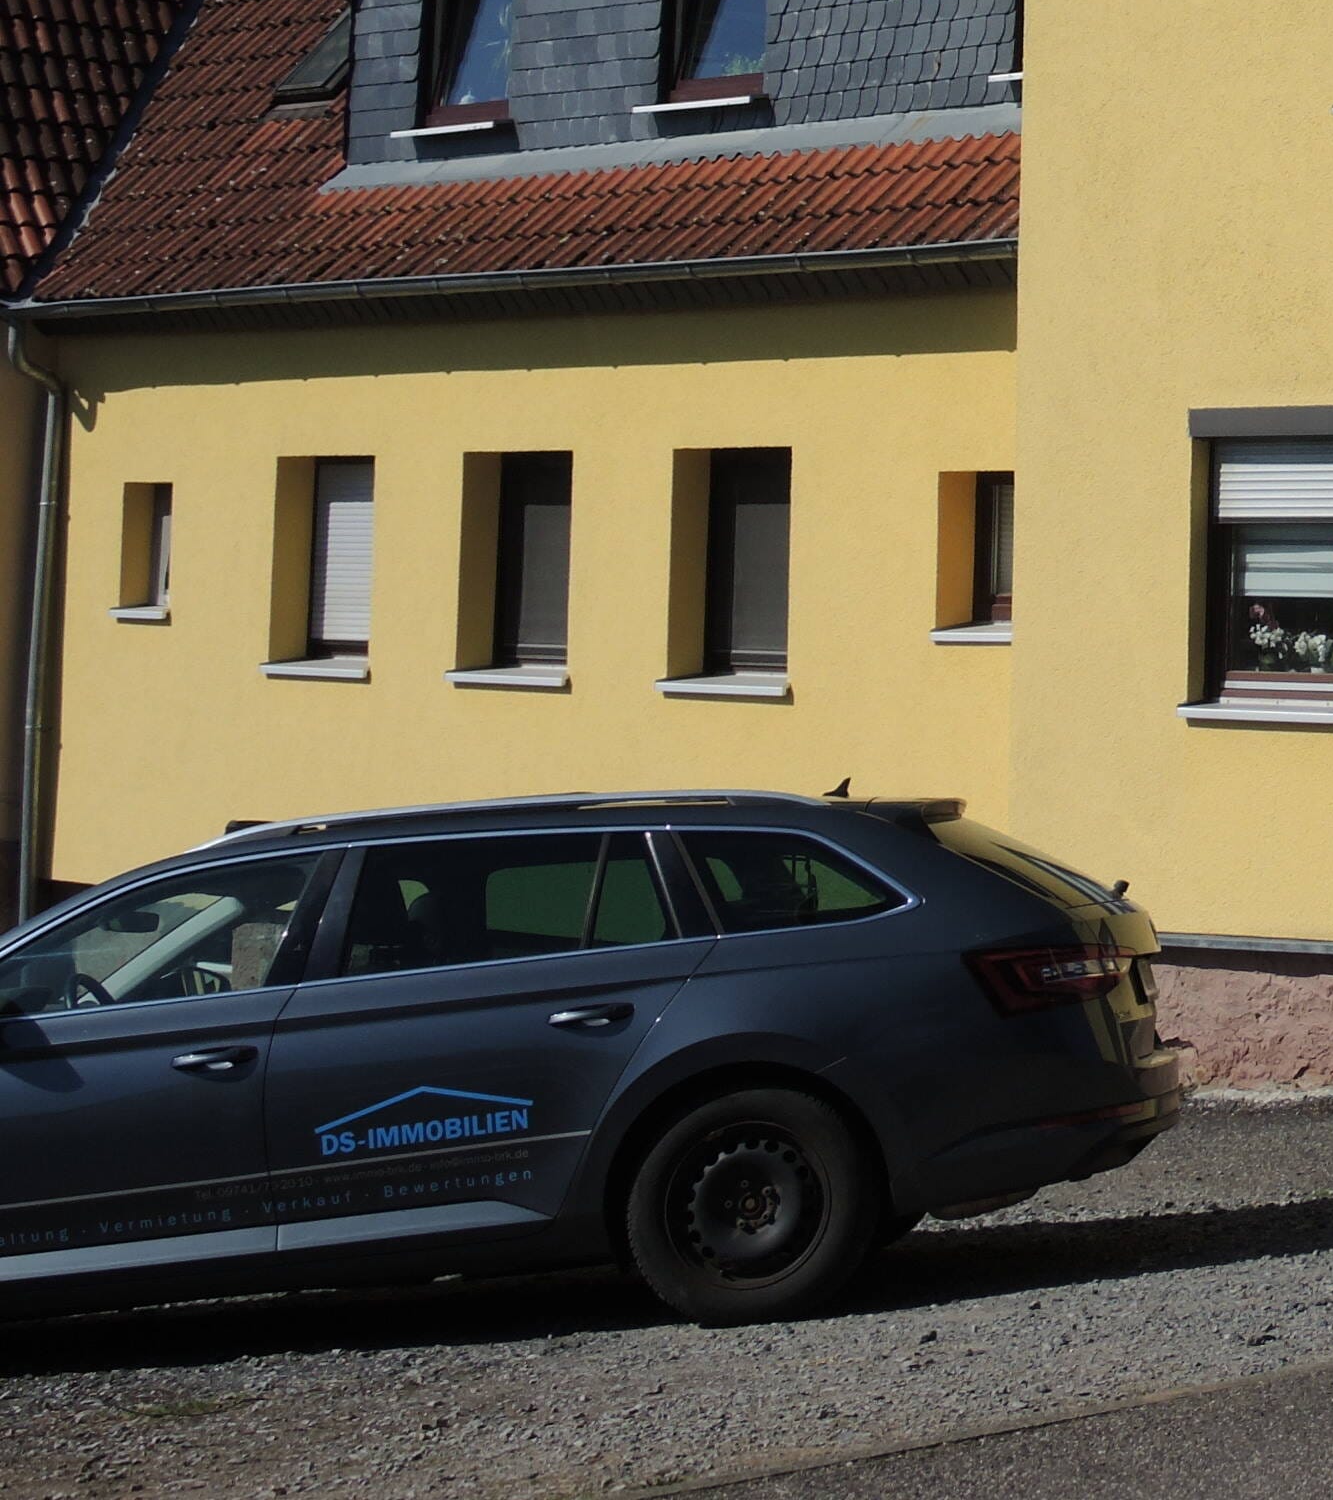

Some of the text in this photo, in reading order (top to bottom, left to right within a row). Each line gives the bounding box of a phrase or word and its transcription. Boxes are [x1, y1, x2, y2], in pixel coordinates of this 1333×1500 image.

[321, 1108, 529, 1157] DS-IMMOBILIEN
[99, 1206, 233, 1235] Vermietung
[262, 1188, 351, 1215] Verkauf
[383, 1167, 533, 1199] Bewertungen
